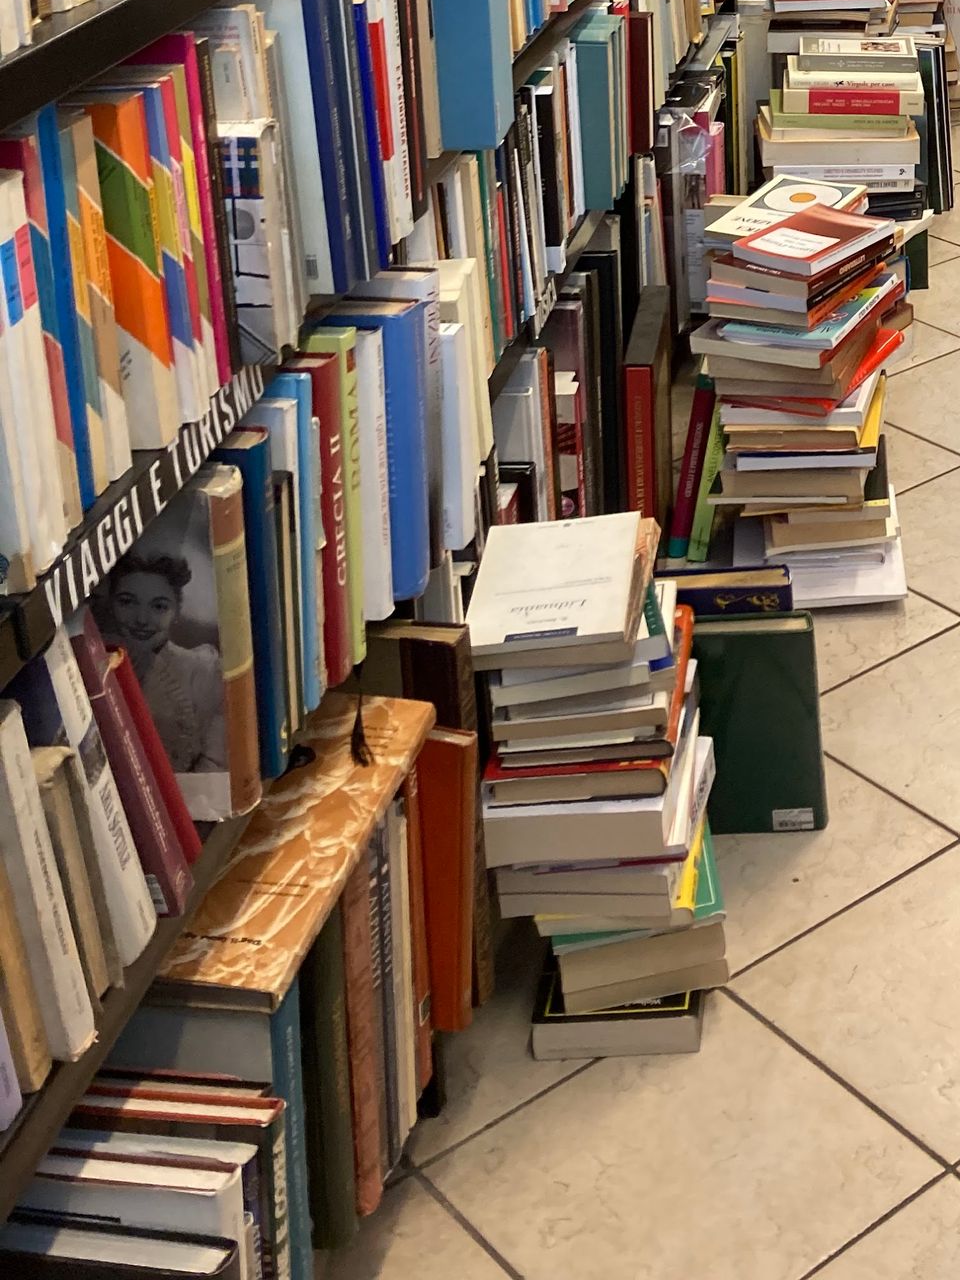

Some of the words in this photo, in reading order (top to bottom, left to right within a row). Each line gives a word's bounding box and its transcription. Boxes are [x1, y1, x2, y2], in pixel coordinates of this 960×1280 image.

[401, 149, 410, 200] ITALIANA
[330, 432, 341, 455] II
[346, 373, 361, 493] ROMA
[44, 484, 144, 630] VIAGGI
[150, 460, 168, 516] E
[167, 364, 266, 491] TURISMO
[332, 468, 346, 588] GRECIA
[98, 780, 114, 820] ARIA
[107, 818, 131, 872] SOTTILE
[368, 896, 381, 989] ALPINISTI
